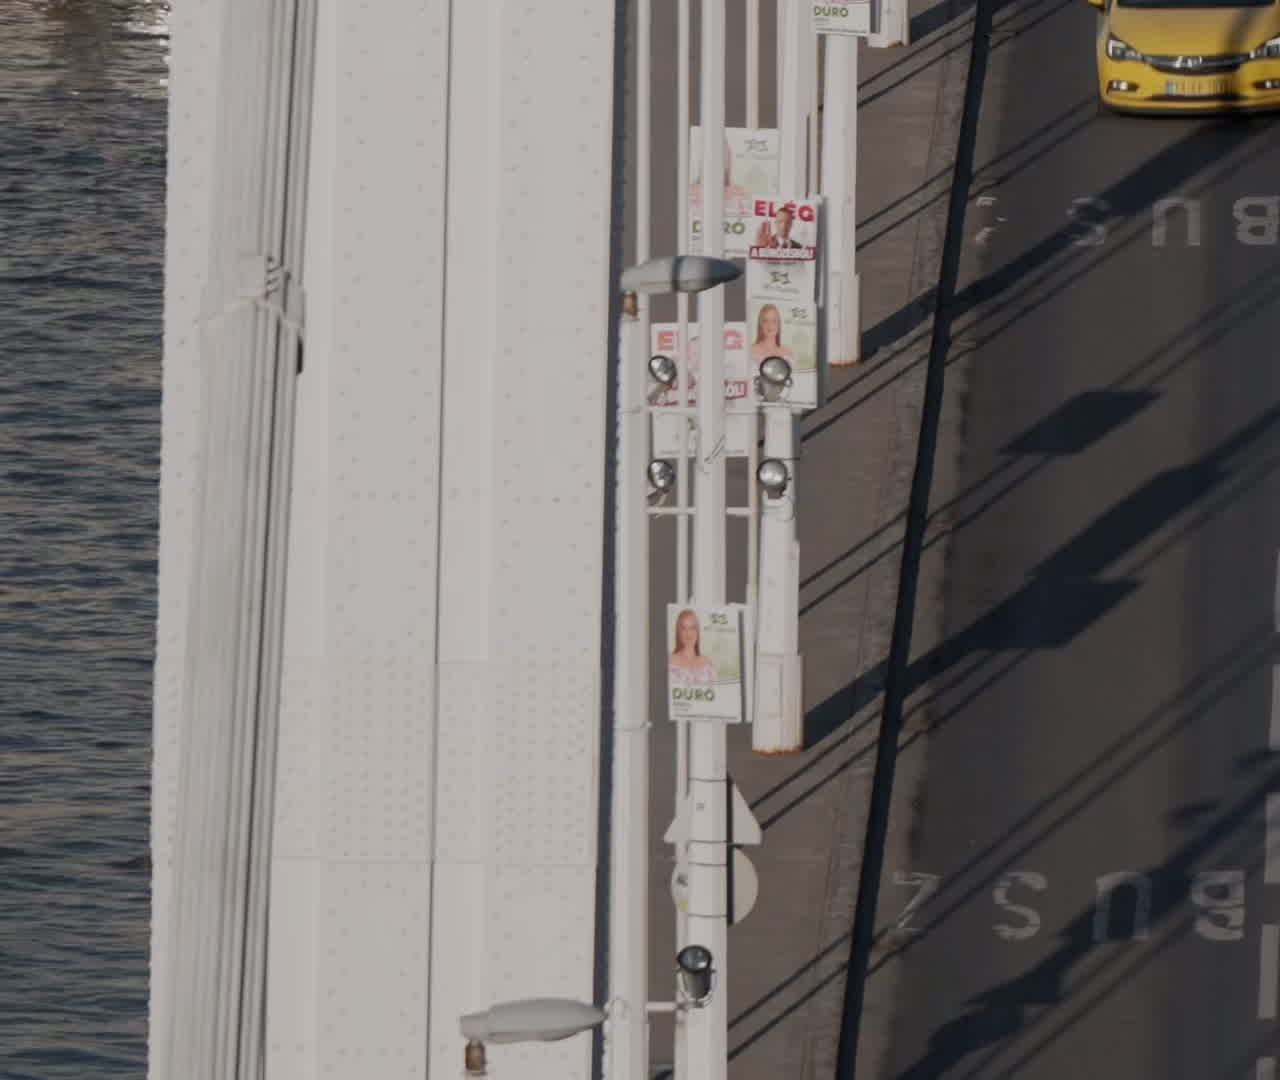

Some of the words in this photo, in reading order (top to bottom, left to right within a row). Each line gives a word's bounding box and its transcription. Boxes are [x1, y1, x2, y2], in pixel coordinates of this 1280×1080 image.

[813, 4, 849, 18] DURÓ
[692, 220, 746, 237] DRÓ
[672, 685, 716, 702] DURÓ
